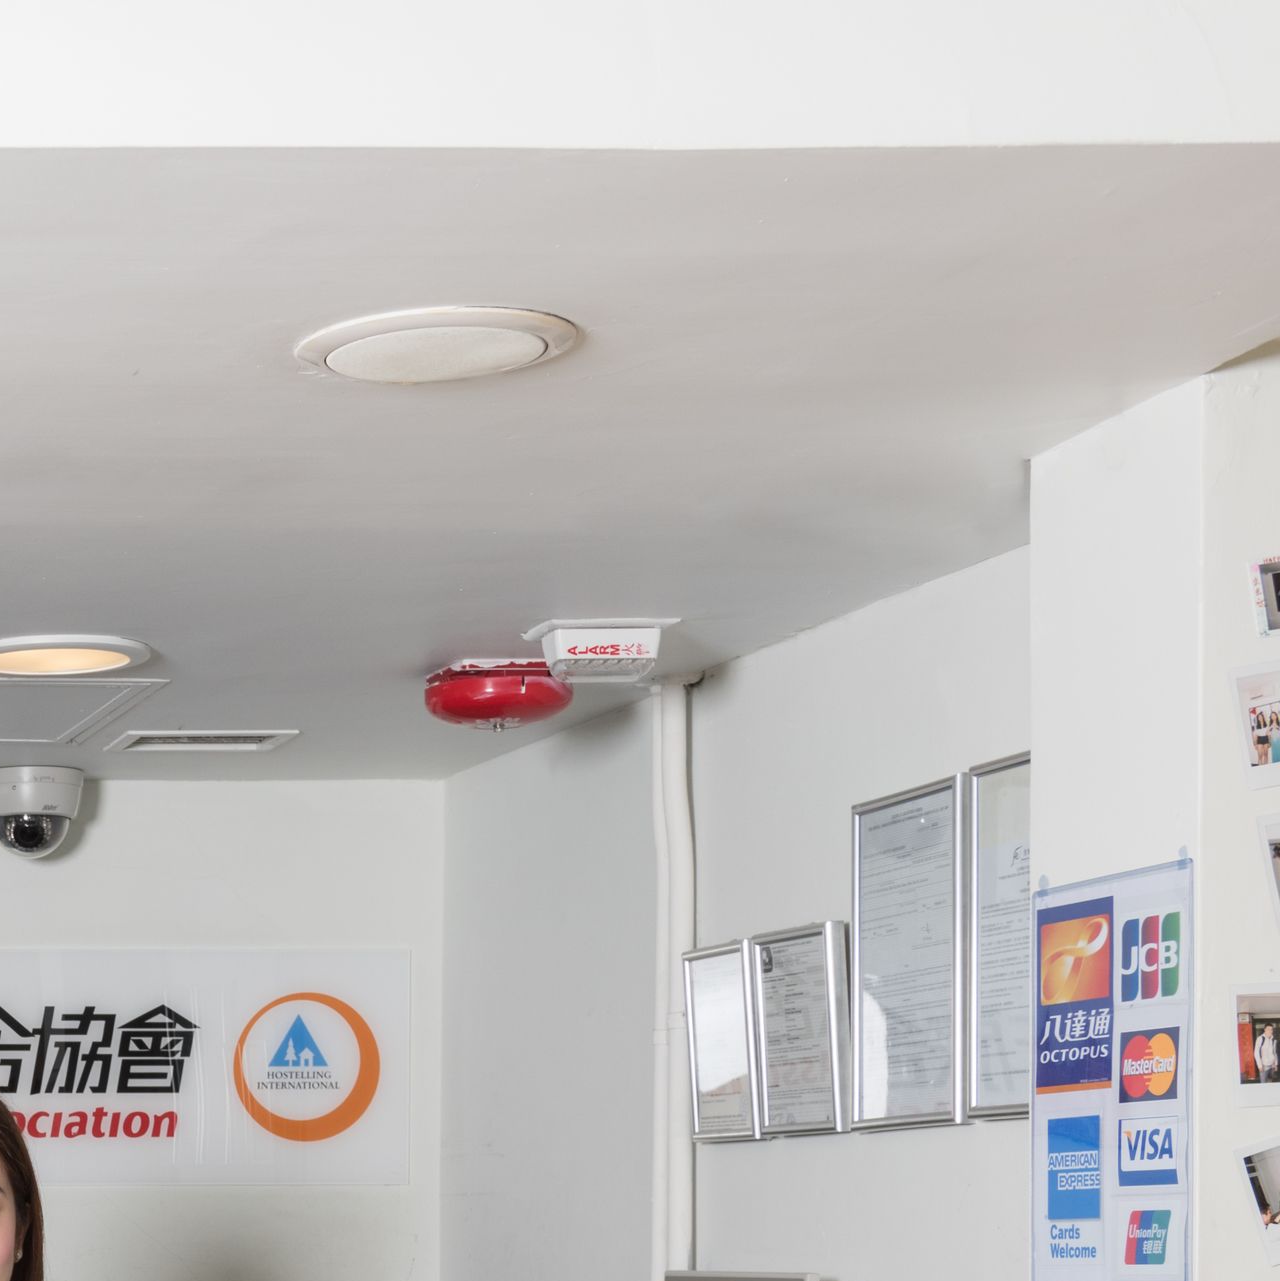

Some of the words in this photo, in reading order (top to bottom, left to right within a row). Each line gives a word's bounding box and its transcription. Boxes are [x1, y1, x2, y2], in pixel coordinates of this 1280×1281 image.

[567, 644, 620, 656] ALARM
[1121, 938, 1179, 977] JCB
[1040, 1008, 1111, 1045] 八達通
[1040, 1044, 1109, 1064] OCTOPUS
[1122, 1053, 1175, 1078] MasterCard
[266, 1071, 332, 1080] HOSTELLING
[257, 1081, 340, 1090] INTERNATIONAL
[1126, 1127, 1174, 1162] VISA
[1048, 1152, 1098, 1170] AMERICAN
[1058, 1172, 1101, 1190] EXPRESS
[1050, 1224, 1080, 1241] Cards
[1128, 1223, 1168, 1244] UnionPay
[1050, 1243, 1097, 1260] Welcome
